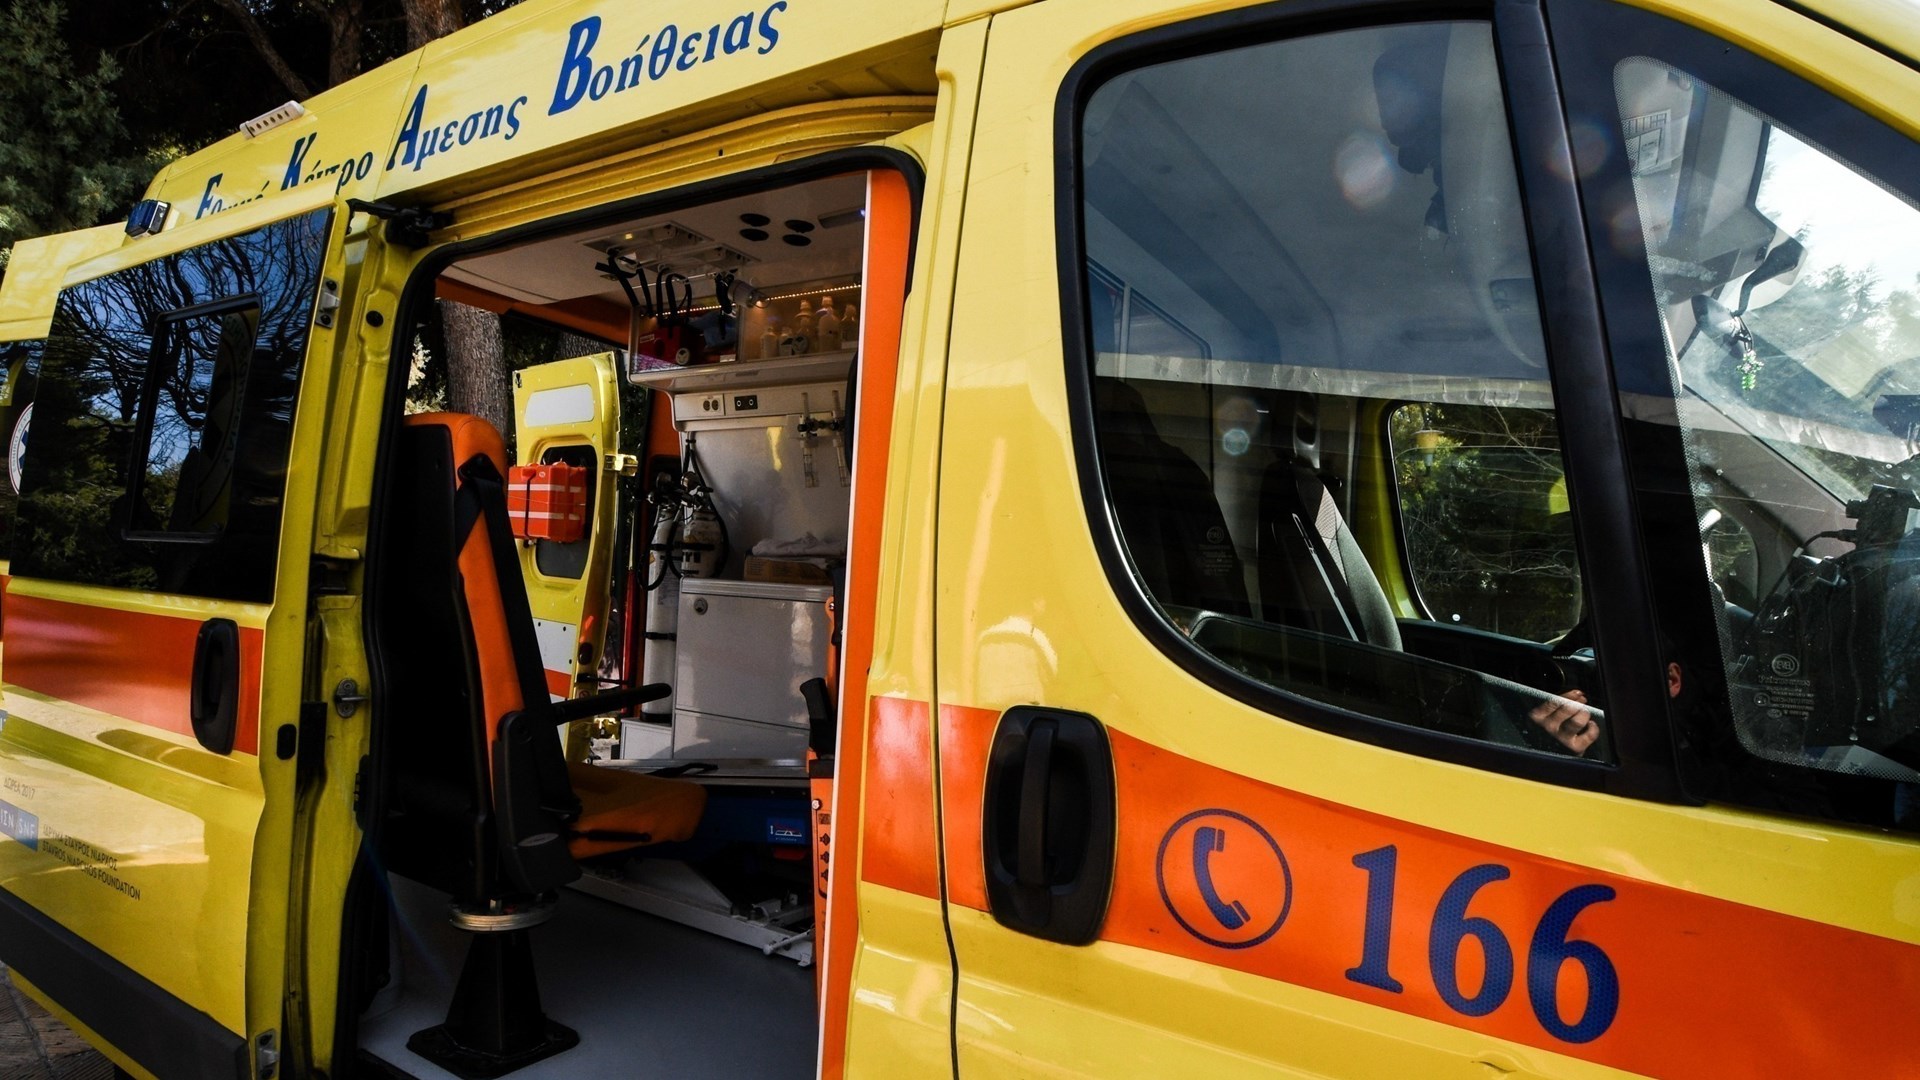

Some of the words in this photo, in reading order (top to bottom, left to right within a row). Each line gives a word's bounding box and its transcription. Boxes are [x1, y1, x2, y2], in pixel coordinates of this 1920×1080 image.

[387, 84, 528, 173] Αμεσης
[548, 1, 788, 116] Βοήθειας
[98, 869, 141, 902] FOUNDATION
[1345, 844, 1620, 1044] 166
